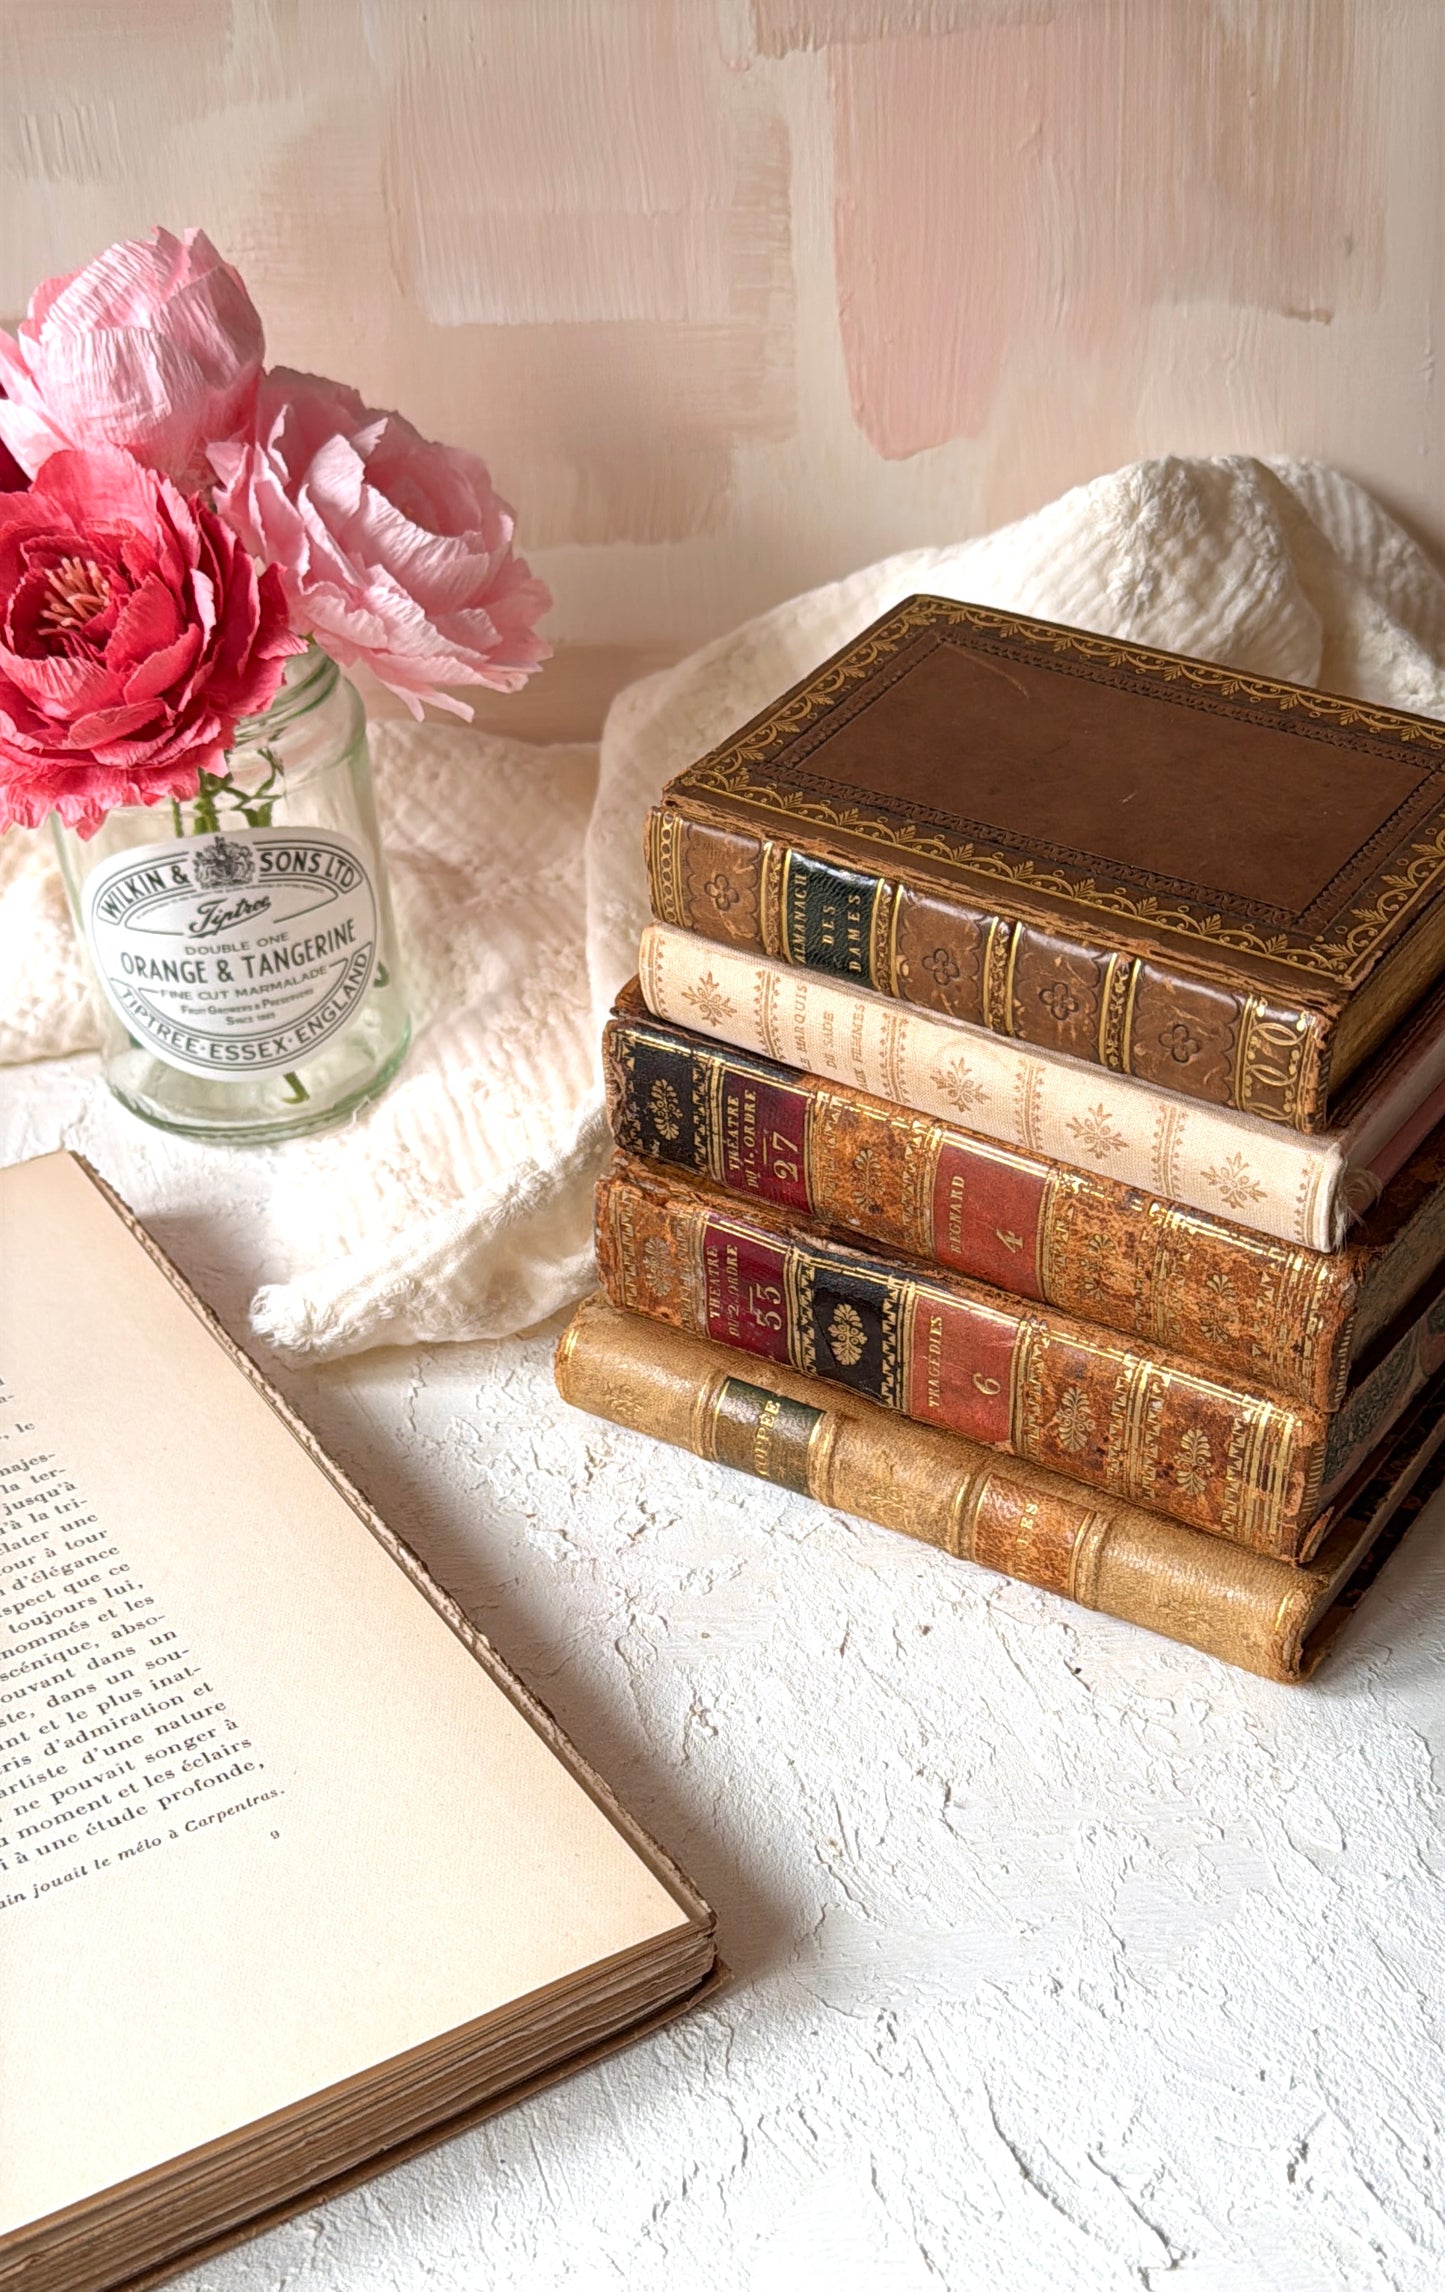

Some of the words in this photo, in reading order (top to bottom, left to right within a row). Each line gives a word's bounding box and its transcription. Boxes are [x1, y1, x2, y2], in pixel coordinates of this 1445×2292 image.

[100, 869, 167, 919] WILKIN
[170, 864, 192, 885] &
[259, 850, 322, 872] SONS
[324, 856, 355, 888] LTD
[184, 941, 250, 956] DOUBLE
[256, 931, 289, 948] ONE
[188, 896, 271, 938] Tiptree
[792, 873, 807, 964] ALMANACH
[821, 904, 836, 946] DES
[847, 894, 862, 973] DAMES
[120, 952, 208, 984] ORANGE
[217, 959, 235, 983] &
[241, 918, 356, 979] TANGERINE
[122, 987, 199, 1055] TIPTREE
[209, 1037, 289, 1061] ESSEX
[294, 952, 368, 1044] ENGLAND
[160, 988, 192, 1001] FINE
[198, 989, 229, 1001] CUT
[234, 965, 328, 998] MARMALADE
[794, 984, 808, 1053] MARQUIS
[743, 1089, 757, 1148] ORDRE
[772, 1130, 799, 1183] 27
[948, 1175, 965, 1254] REGNARD
[995, 1227, 1024, 1254] 4
[726, 1244, 739, 1297] ORDRE
[972, 1371, 1001, 1395] 6
[0, 1483, 21, 1494] la
[29, 1468, 66, 1484] ter-
[27, 1512, 50, 1524] la
[53, 1498, 88, 1515] tri-
[59, 1514, 99, 1533] une
[43, 1547, 57, 1559] à
[64, 1529, 108, 1551] tour
[62, 1574, 102, 1595] que
[108, 1563, 131, 1576] ce
[7, 1596, 98, 1634] toujours
[102, 1579, 144, 1599] lui,
[97, 1608, 118, 1623] et
[123, 1596, 155, 1613] les
[110, 1615, 166, 1640] abso-
[86, 1646, 137, 1671] dans
[148, 1630, 178, 1647] un
[38, 1719, 61, 1735] et
[65, 1710, 89, 1724] le
[95, 1688, 143, 1716] plus
[148, 1667, 202, 1691] inat-
[46, 1683, 97, 1709] dans
[104, 1669, 135, 1686] un
[144, 1649, 190, 1671] sou-
[43, 1695, 185, 1757] d'admiration
[192, 1681, 214, 1697] et
[81, 1734, 145, 1765] d'une
[154, 1702, 227, 1736] nature
[13, 1799, 41, 1817] ne
[49, 1760, 136, 1806] pouvait
[144, 1728, 217, 1764] songer
[223, 1718, 239, 1731] à
[16, 1793, 113, 1840] moment
[117, 1782, 140, 1799] et
[142, 1769, 176, 1789] les
[180, 1738, 252, 1773] éclairs
[13, 1851, 30, 1865] à
[35, 1833, 80, 1857] une
[85, 1805, 149, 1836] étude
[156, 1762, 265, 1811] profonde,
[269, 1830, 281, 1840] 9
[32, 1865, 89, 1900] jouait
[93, 1858, 112, 1871] le
[117, 1837, 162, 1861] mélo
[168, 1829, 180, 1840] à
[184, 1789, 286, 1833] Carpentras.
